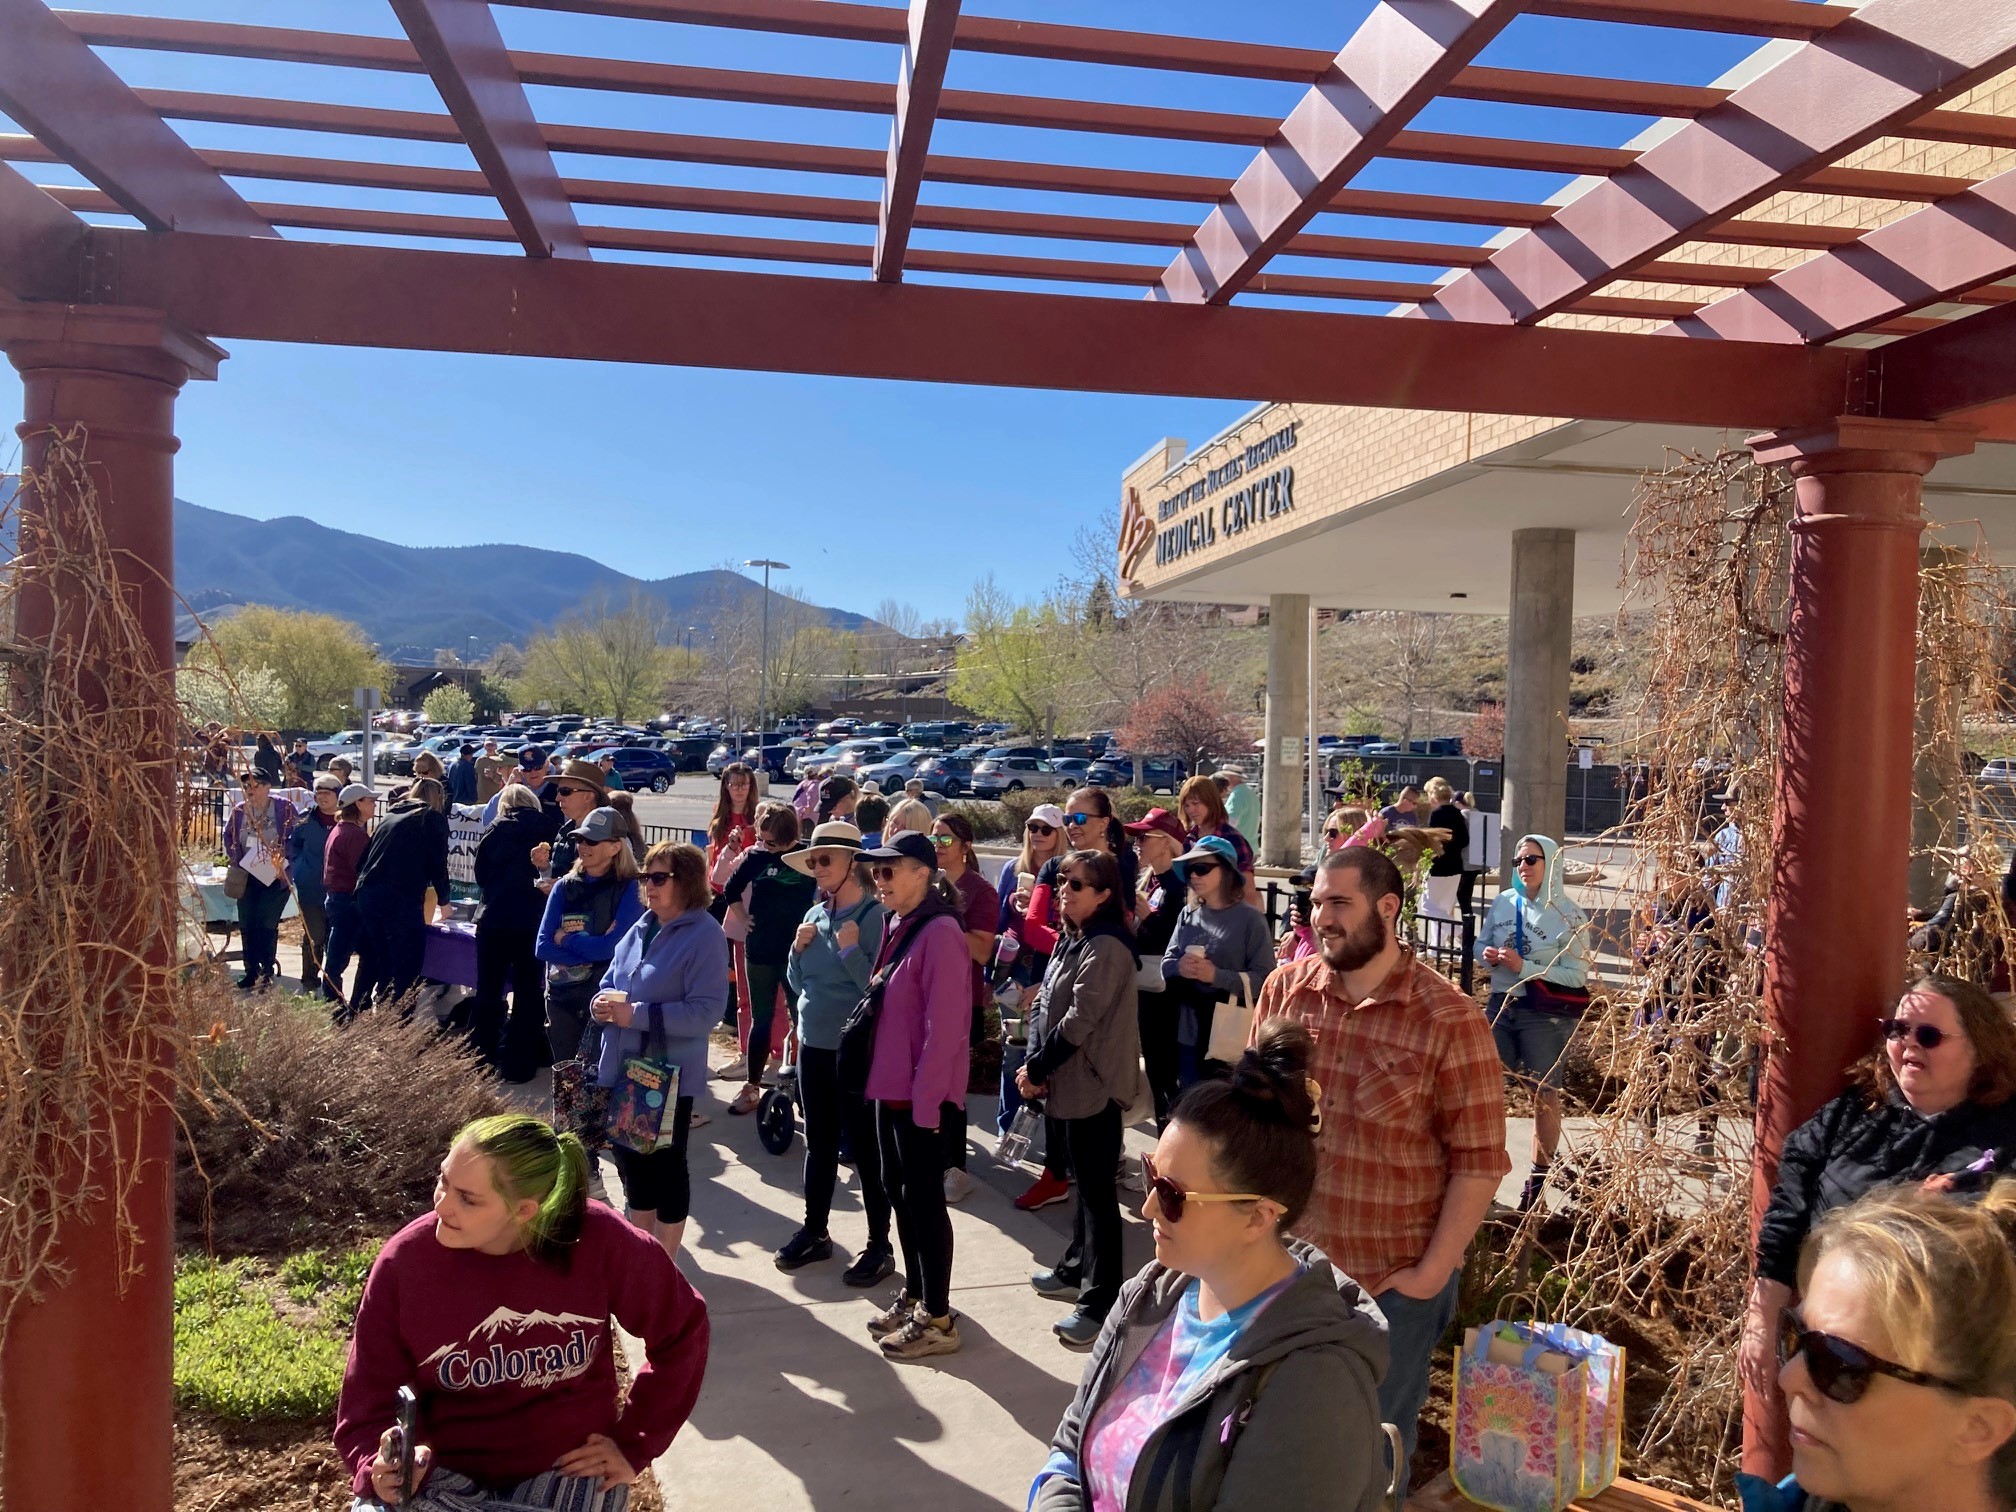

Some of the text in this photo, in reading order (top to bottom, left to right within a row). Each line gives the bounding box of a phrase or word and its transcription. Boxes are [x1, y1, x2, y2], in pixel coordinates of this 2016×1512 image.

[1192, 478, 1206, 504] THE
[1207, 454, 1242, 496] ROCKIES
[1245, 422, 1297, 474] REGIONAL
[1156, 465, 1293, 567] MEDICAL CENTER
